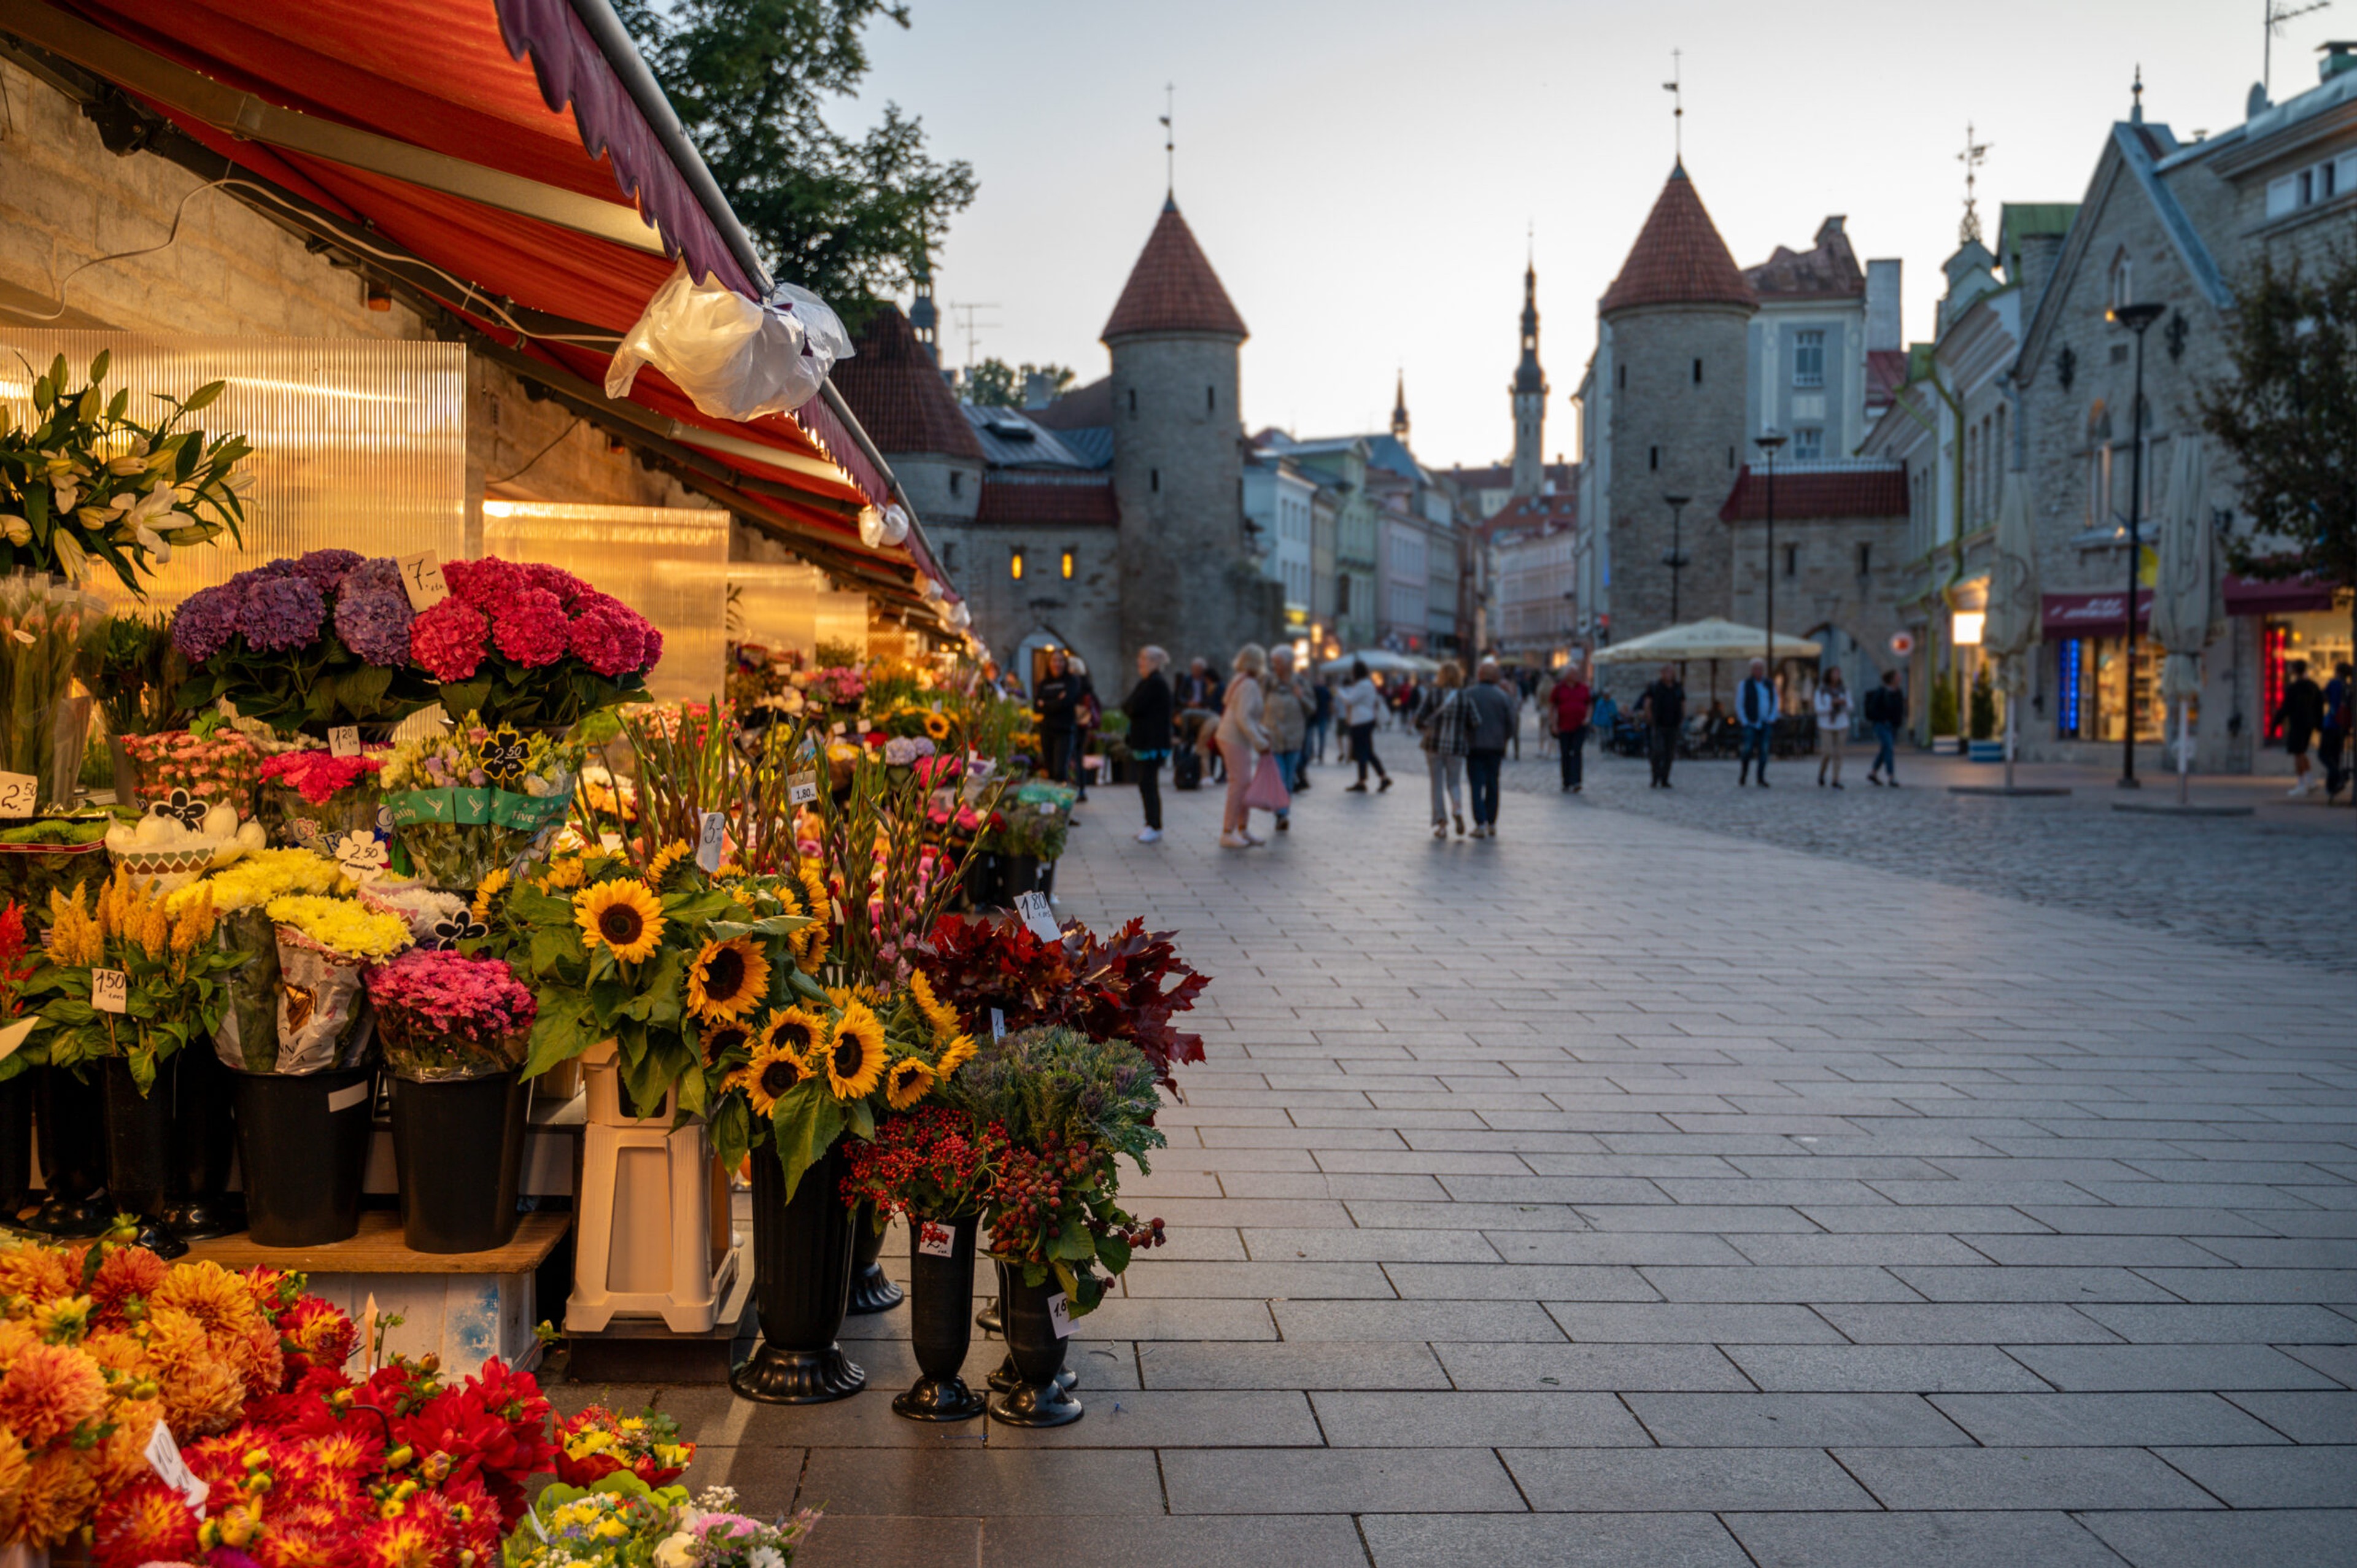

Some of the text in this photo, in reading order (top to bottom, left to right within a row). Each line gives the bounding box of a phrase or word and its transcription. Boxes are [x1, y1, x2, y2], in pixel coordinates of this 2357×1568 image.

[796, 788, 811, 800] 1,80
[350, 843, 378, 860] 2.50
[96, 970, 125, 993] 1.50
